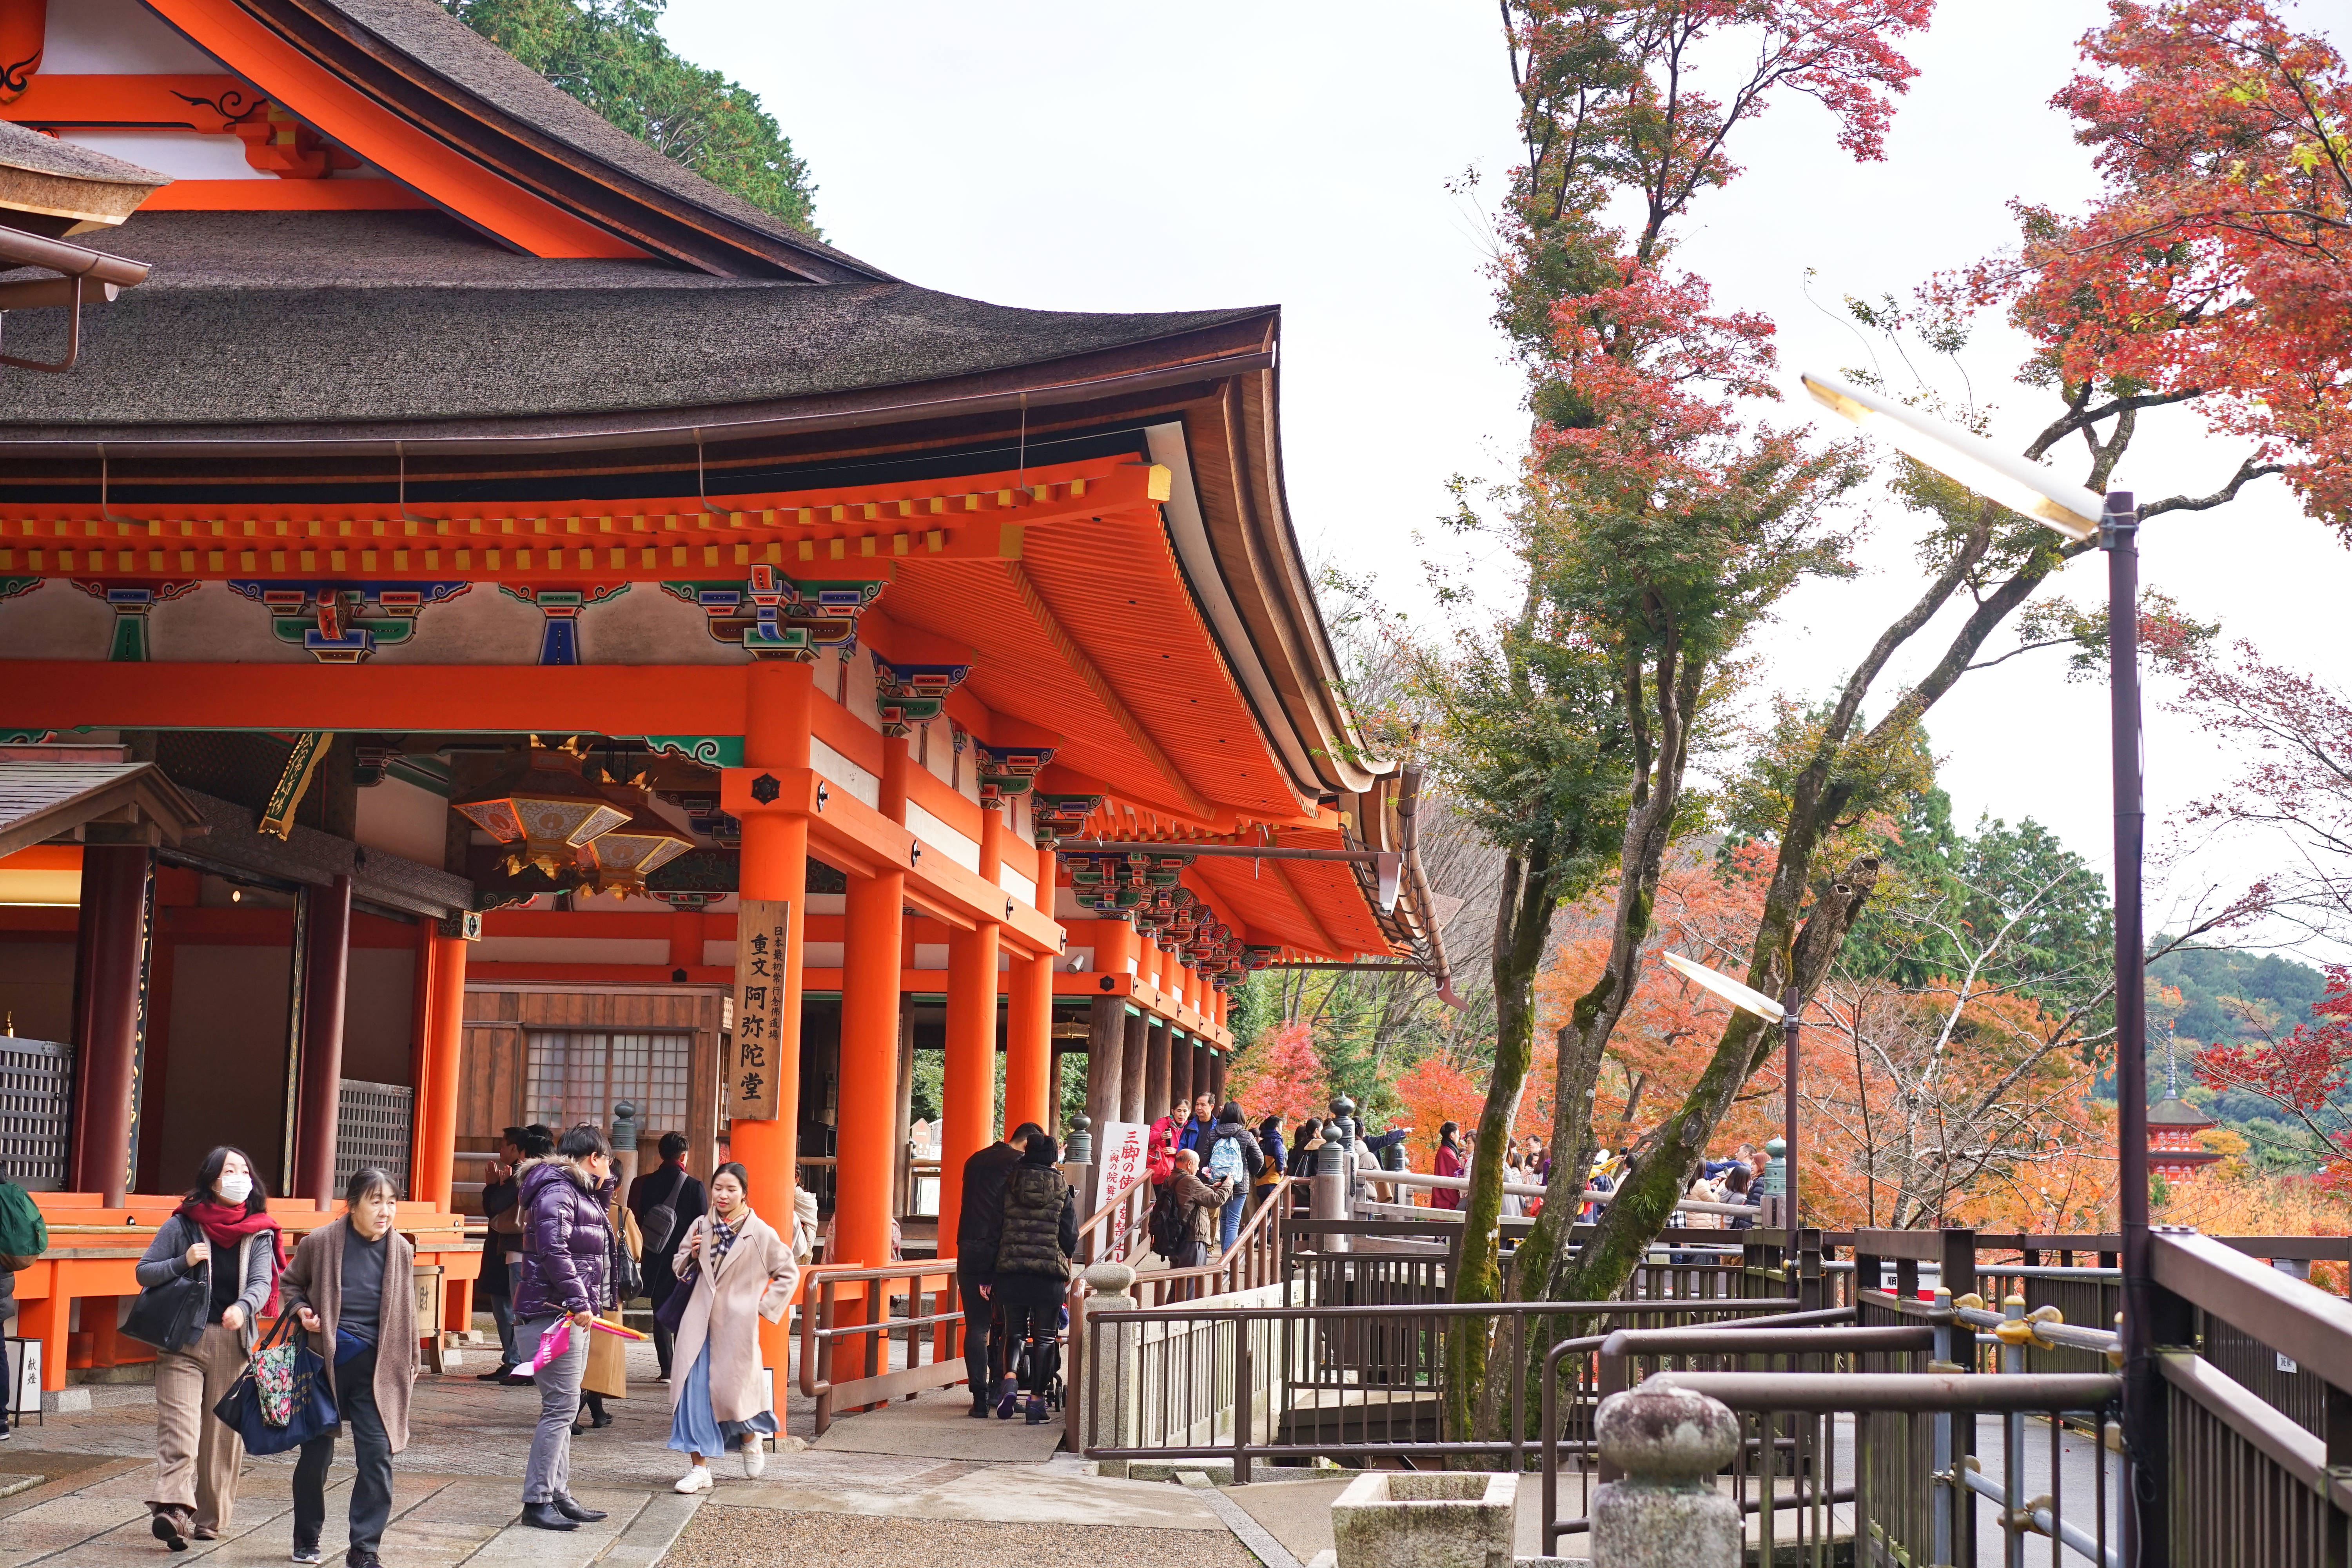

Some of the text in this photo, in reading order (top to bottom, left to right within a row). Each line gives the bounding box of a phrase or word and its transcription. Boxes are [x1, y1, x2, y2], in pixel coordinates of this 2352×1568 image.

[768, 926, 784, 1041] 日本最初常行念佛道場
[27, 1356, 37, 1385] 献燈
